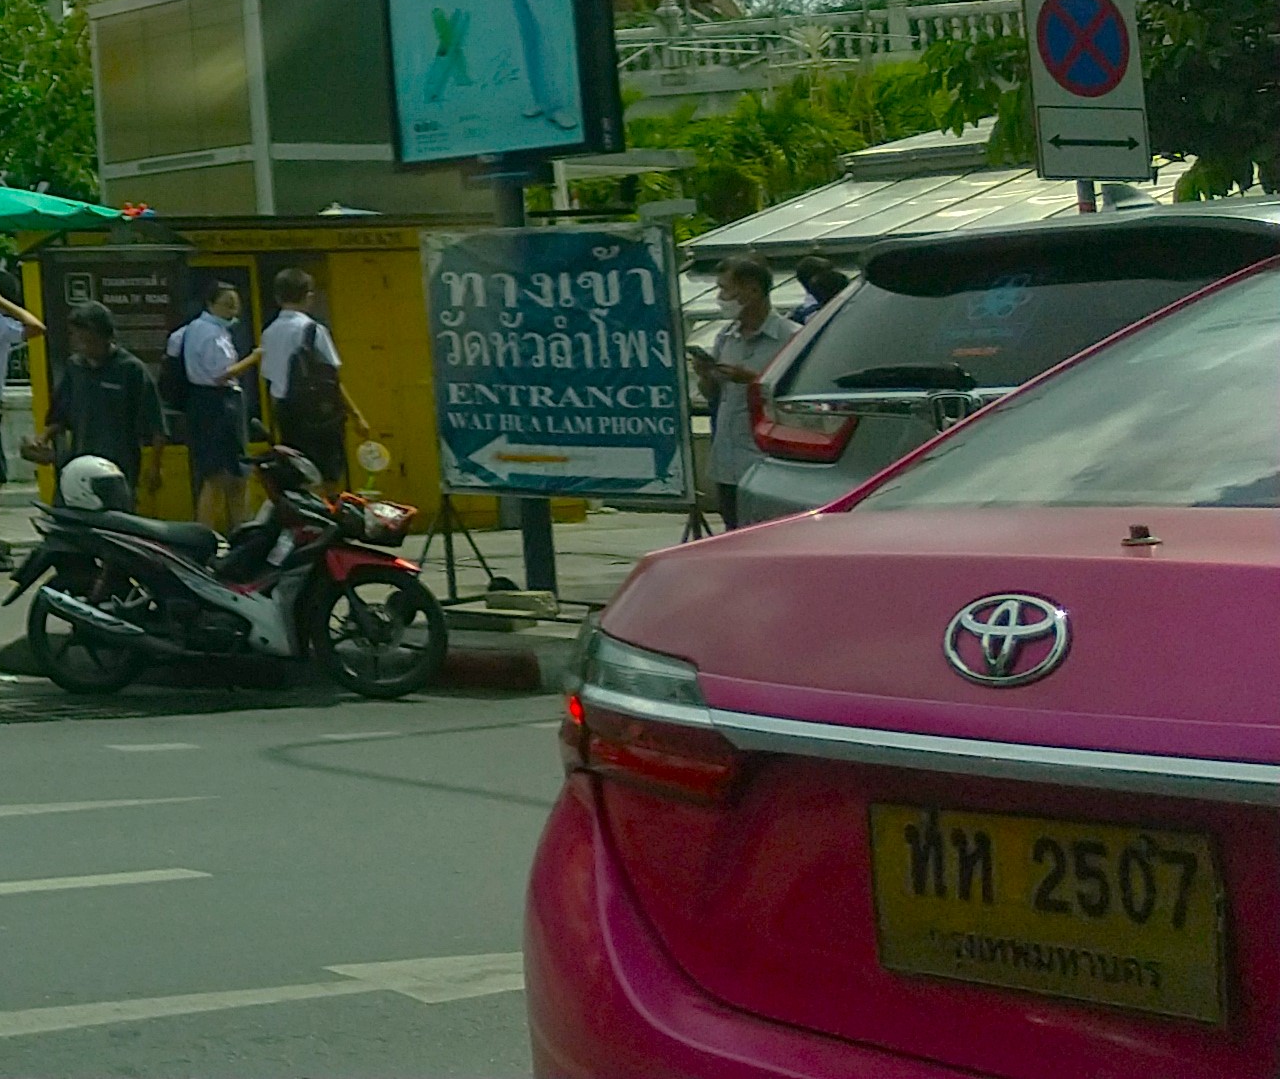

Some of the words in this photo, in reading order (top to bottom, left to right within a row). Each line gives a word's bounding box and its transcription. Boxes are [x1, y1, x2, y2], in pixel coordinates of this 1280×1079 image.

[441, 245, 656, 308] ทางเข้า
[436, 308, 674, 369] วัดหัวลำโพง
[447, 382, 675, 409] ENTRANCE
[547, 416, 593, 434] LAM
[599, 416, 675, 436] PHONG
[1032, 833, 1198, 929] 2507
